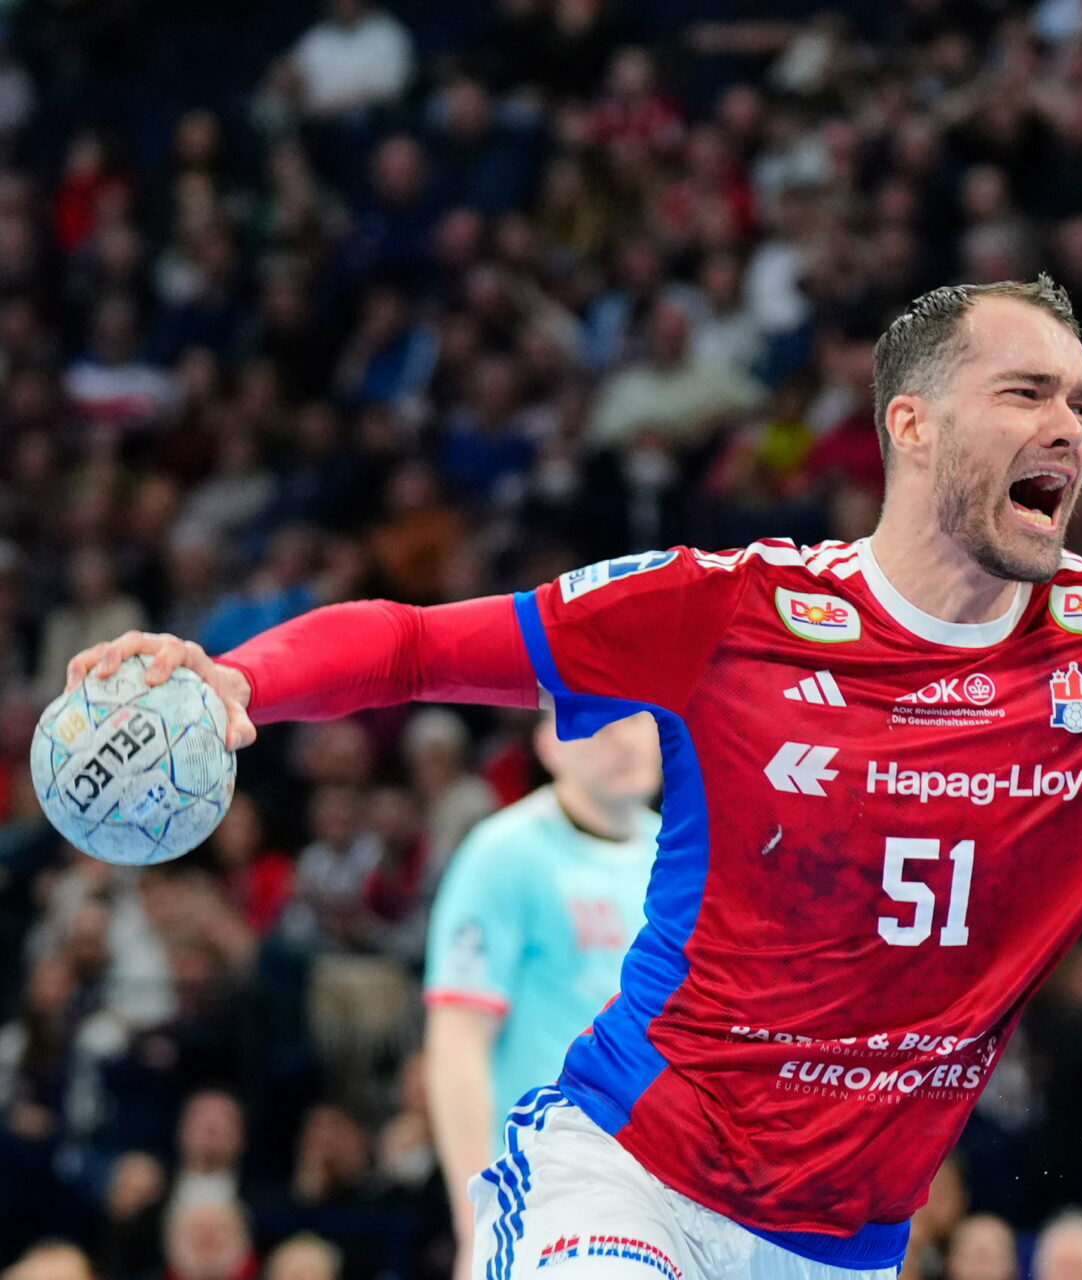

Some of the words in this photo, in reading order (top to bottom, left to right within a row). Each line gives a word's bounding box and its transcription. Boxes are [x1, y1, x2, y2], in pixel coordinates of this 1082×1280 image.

[791, 599, 848, 624] Dole
[895, 678, 963, 704] AOK
[892, 706, 913, 715] AOK
[915, 707, 1006, 718] Rheinland/Hamburg
[892, 714, 906, 724] Die
[66, 713, 156, 814] SELECT
[877, 836, 975, 947] 51
[775, 1079, 849, 1100] EUROPEAN
